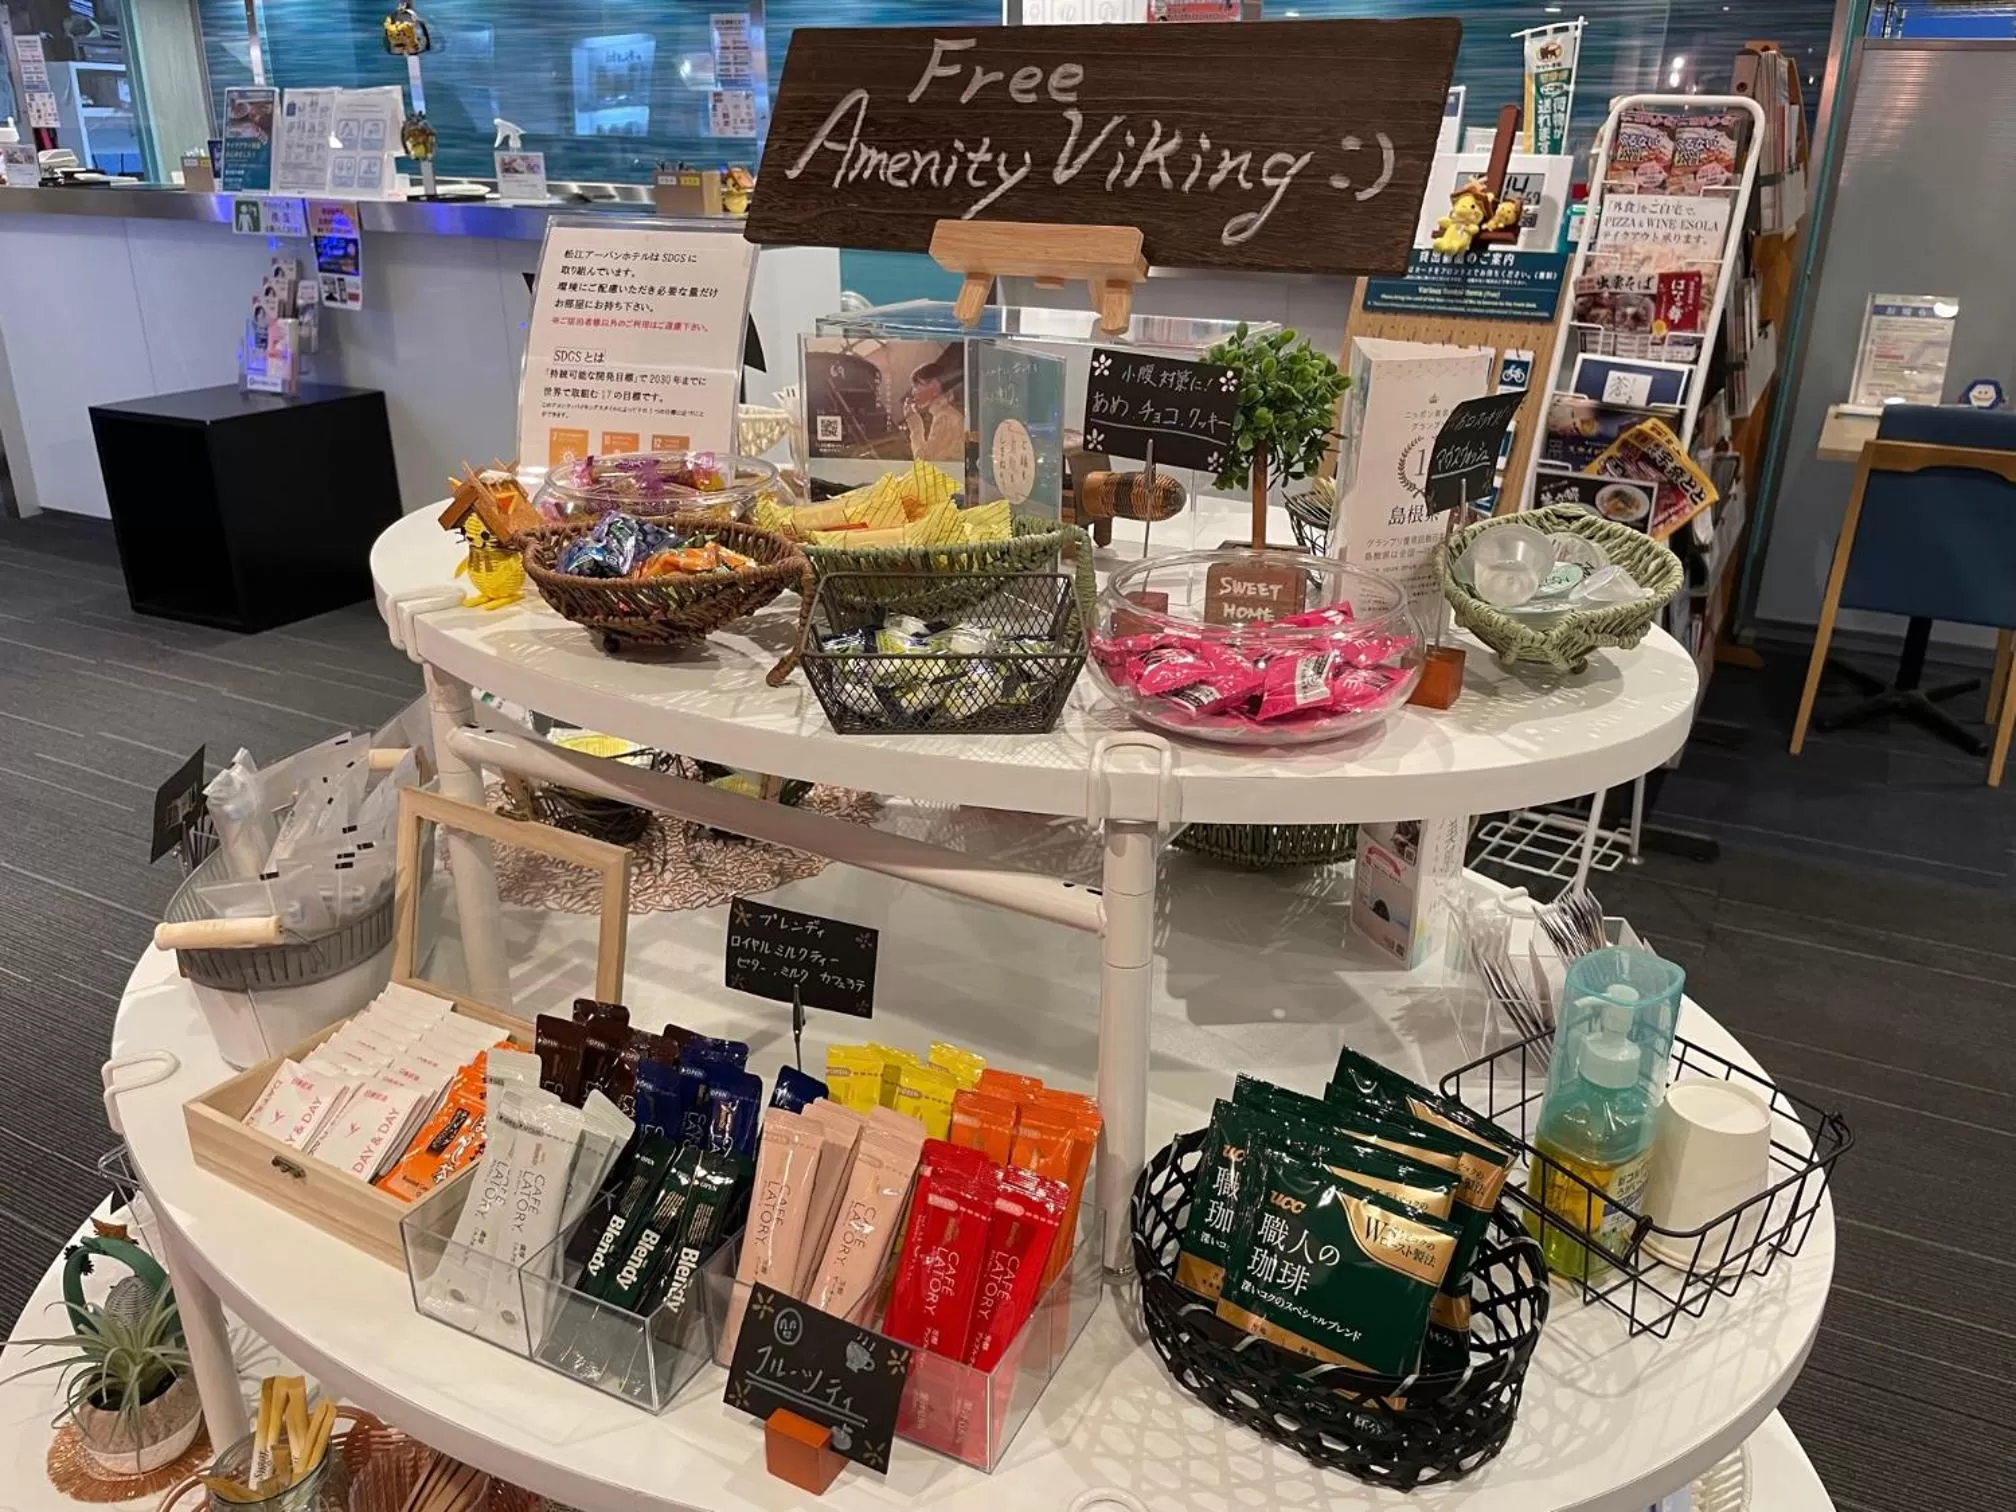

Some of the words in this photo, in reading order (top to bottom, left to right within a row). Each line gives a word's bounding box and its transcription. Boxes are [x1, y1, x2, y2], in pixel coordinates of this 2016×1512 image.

[908, 38, 1086, 104] Free
[785, 88, 1032, 220] Amenity
[1052, 107, 1315, 246] Viking
[1605, 216, 1636, 228] PIZZA
[1647, 217, 1677, 230] WINE
[1680, 219, 1719, 232] ESOLA
[560, 265, 636, 279] 取り組んでいます。
[554, 298, 655, 313] お部屋にお持ち下さい。
[1218, 577, 1283, 601] SWEET
[1222, 602, 1277, 623] HOME
[301, 1096, 322, 1124] DAY
[352, 1146, 375, 1173] DAY
[379, 1107, 400, 1134] DAY
[587, 1213, 627, 1277] Blendy
[616, 1228, 661, 1291] Blendy
[1256, 1211, 1341, 1267] 職人の
[663, 1246, 701, 1314] Blendy
[1246, 1245, 1312, 1297] 珈琲
[1240, 1279, 1363, 1342] 深いコクのスペシャルブレンド
